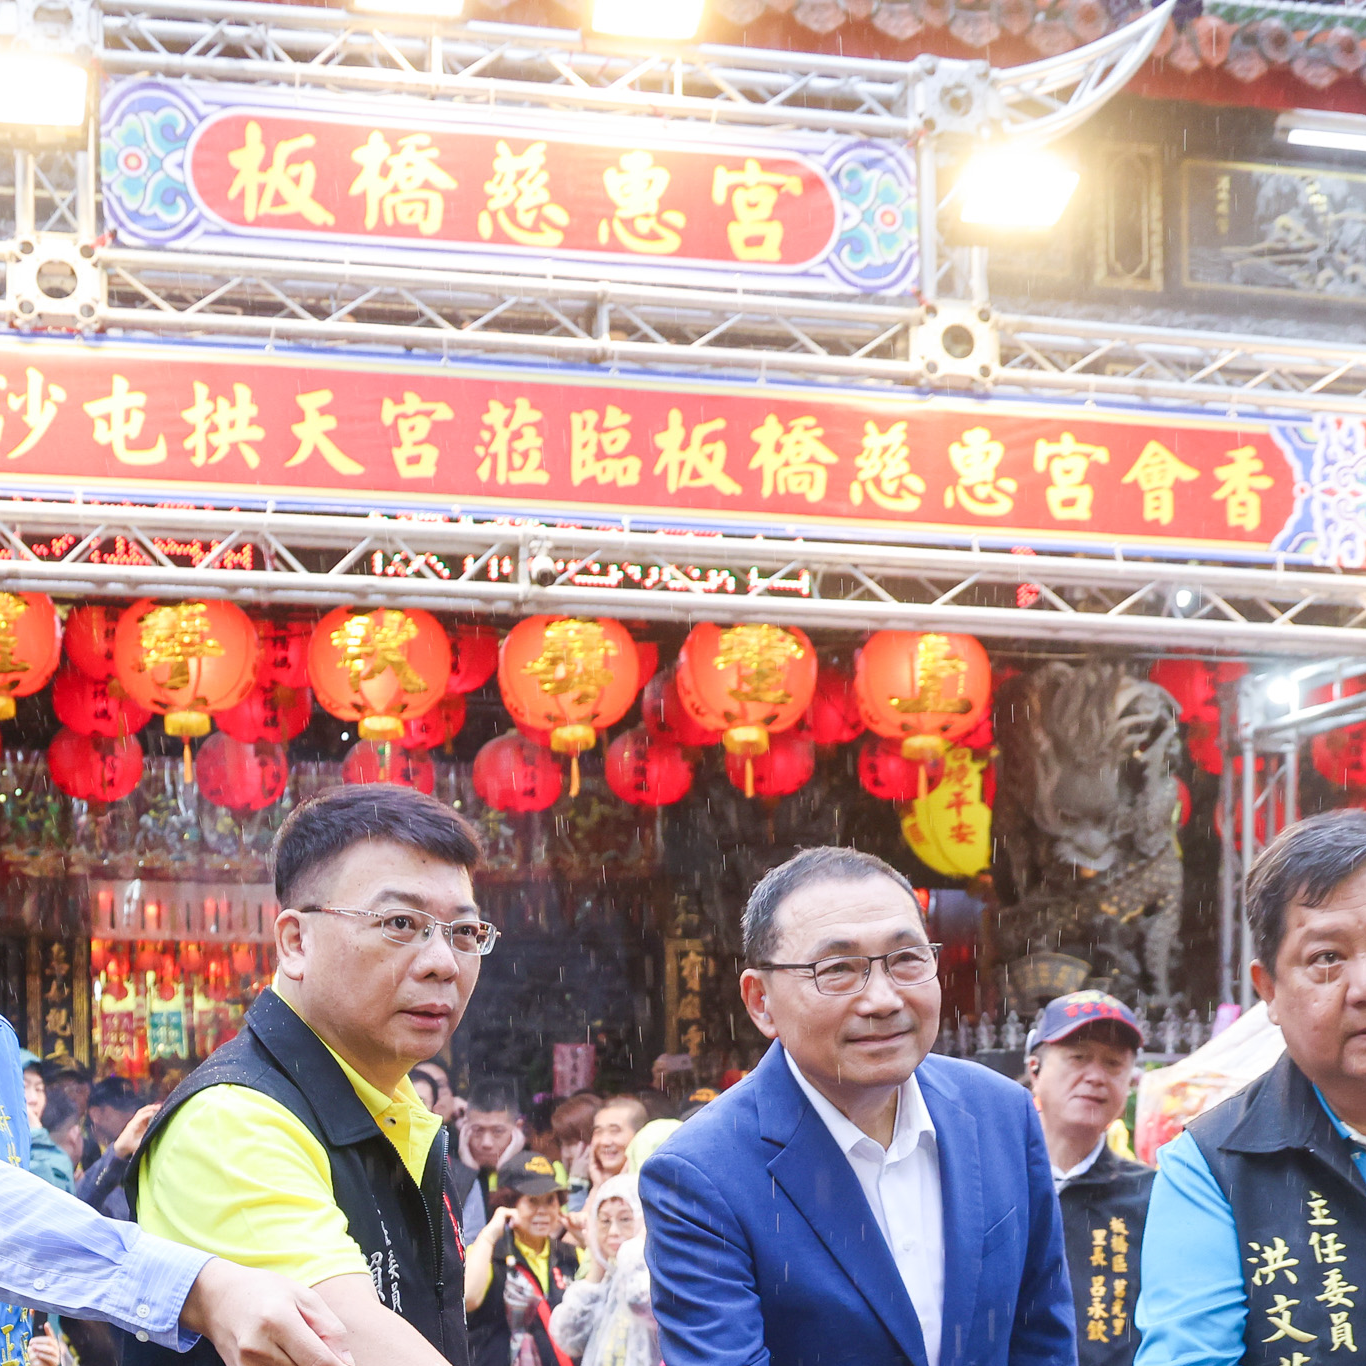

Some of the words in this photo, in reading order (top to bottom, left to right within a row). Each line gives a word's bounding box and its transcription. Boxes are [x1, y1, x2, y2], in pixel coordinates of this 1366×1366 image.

[226, 120, 804, 263] 板橋慈惠宮
[1307, 1190, 1359, 1352] 主任委員
